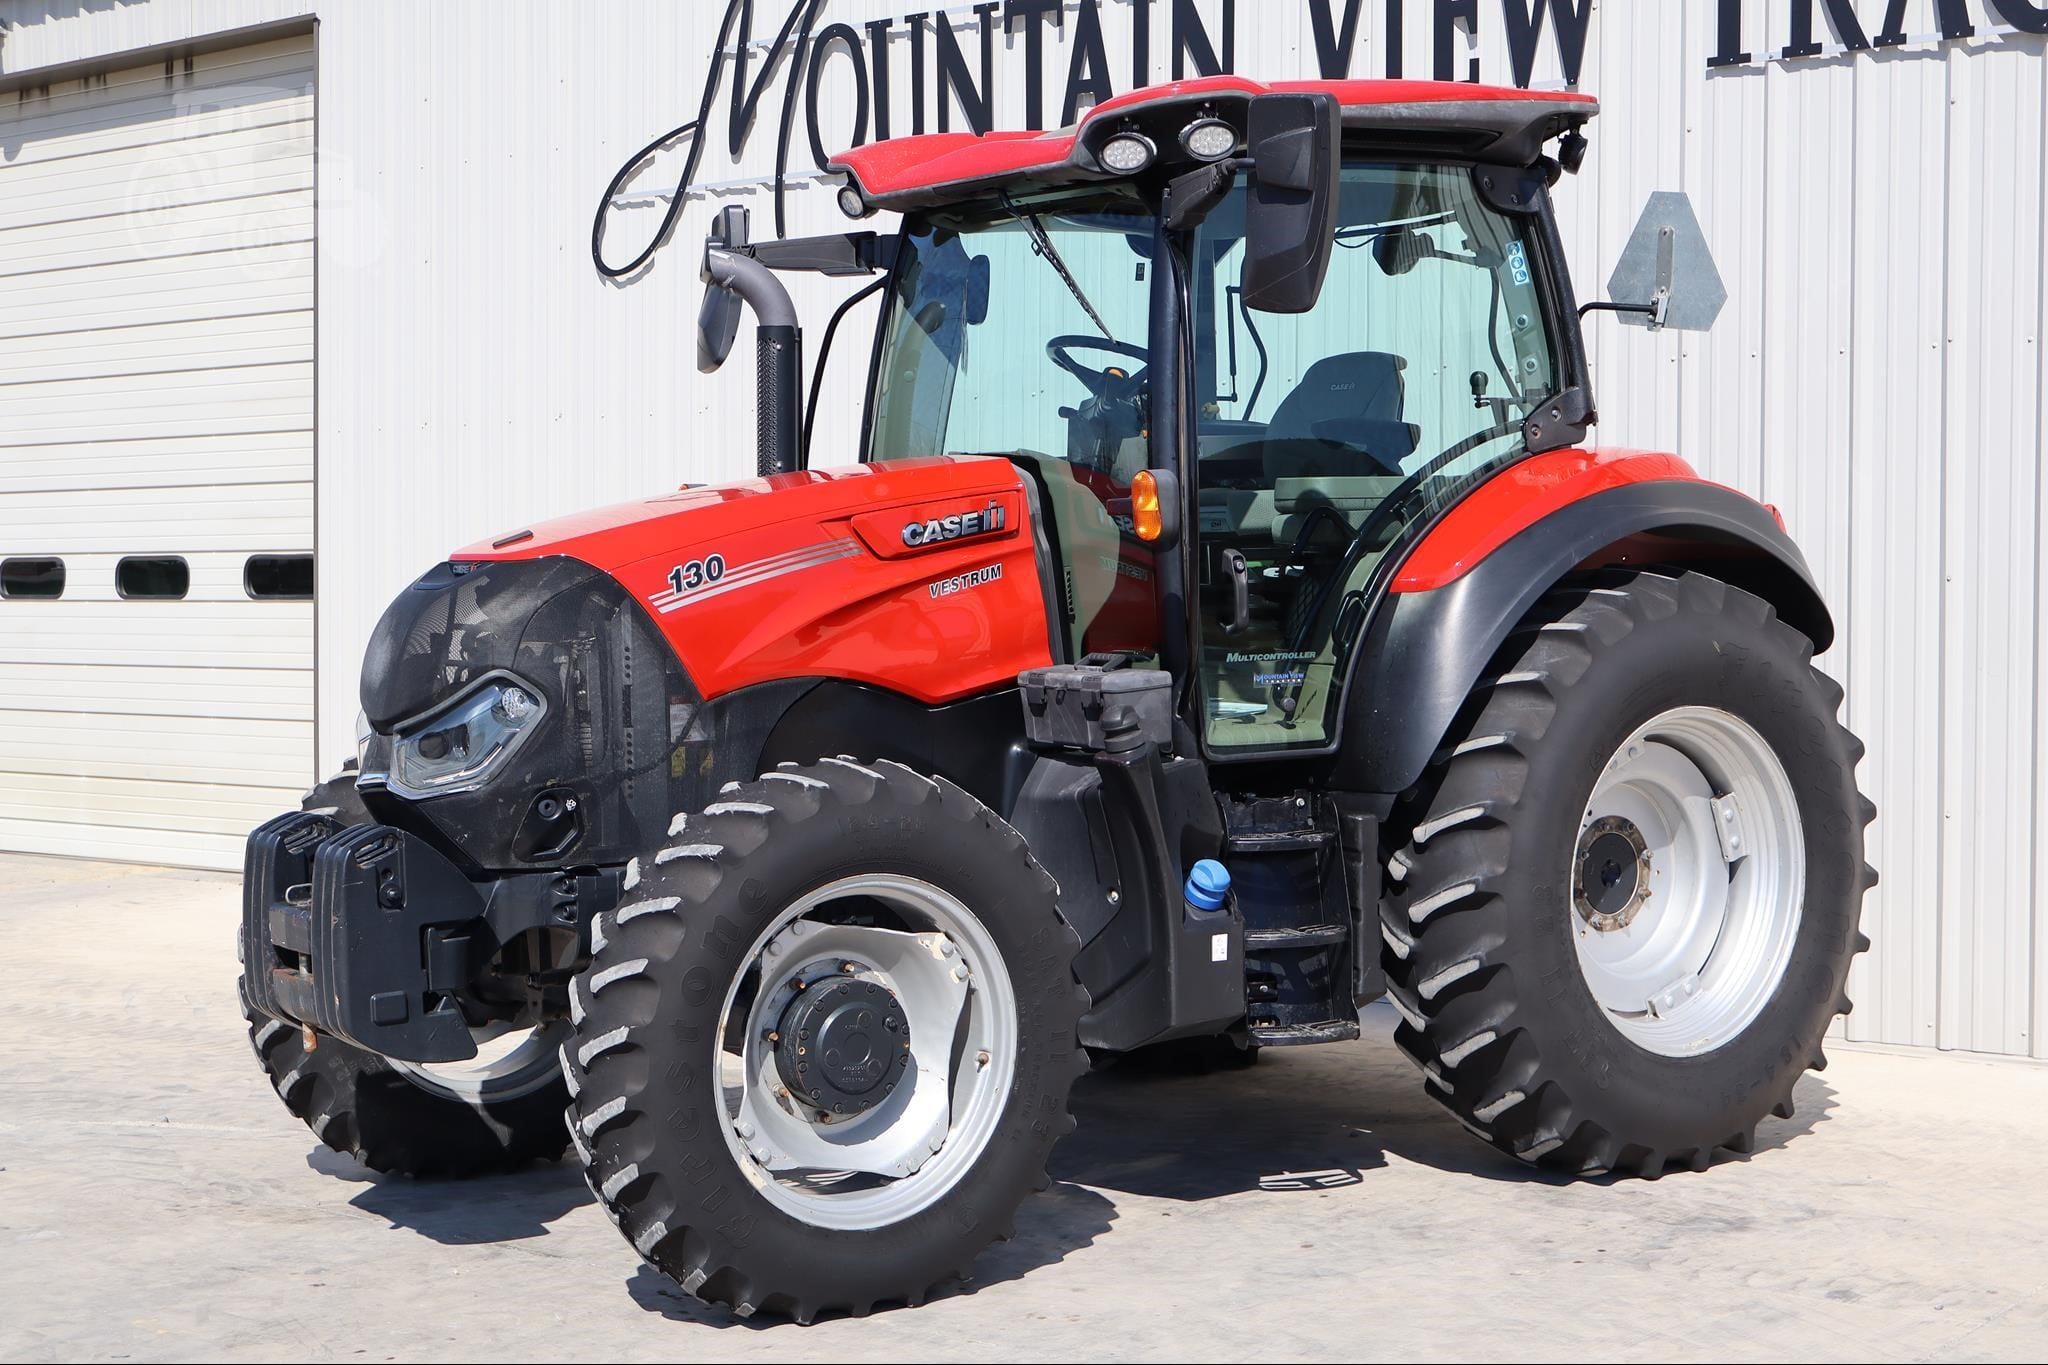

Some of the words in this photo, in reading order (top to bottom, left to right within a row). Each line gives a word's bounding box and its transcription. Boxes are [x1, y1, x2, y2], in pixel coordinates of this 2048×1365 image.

[901, 511, 979, 549] CASE
[667, 553, 726, 596] 130
[929, 563, 1002, 599] VESTRUM
[1255, 673, 1289, 685] MOUNTAIN
[664, 876, 768, 1250] Firestone
